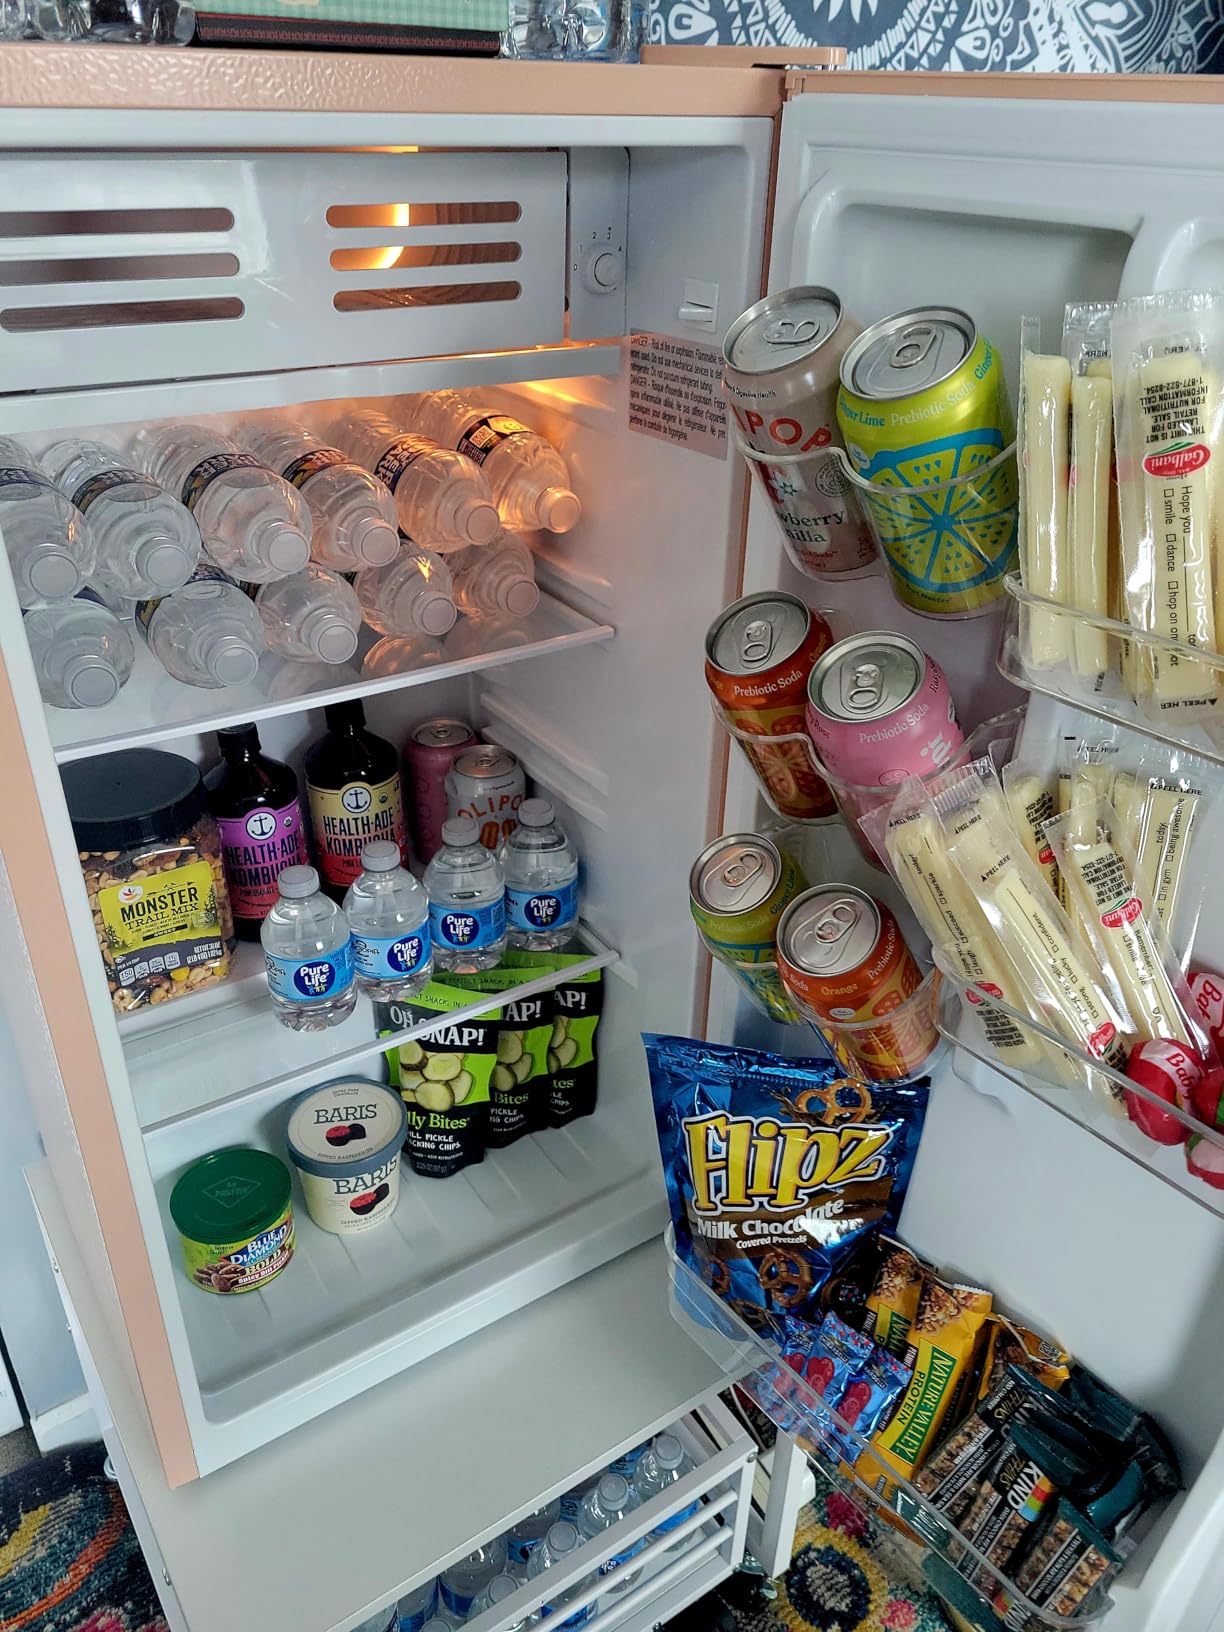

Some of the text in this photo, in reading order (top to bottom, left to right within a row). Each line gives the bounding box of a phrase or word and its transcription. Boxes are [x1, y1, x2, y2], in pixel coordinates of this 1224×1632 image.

[1140, 386, 1208, 406] INFORMATION CALL
[1143, 376, 1203, 395] 1-877-522-8254.
[860, 412, 885, 427] Lime
[890, 403, 945, 427] Prebiotic
[946, 380, 976, 407] Soda
[1144, 396, 1205, 415] FOR NUTRITIONAL
[1152, 408, 1198, 422] RETAIL SALE.
[1152, 424, 1165, 432] FOR
[1146, 434, 1159, 444] NOT
[1150, 449, 1205, 470] Galbani
[1181, 486, 1193, 534] Hope you
[1164, 499, 1178, 625] smile dance hop on
[734, 682, 778, 697] Prebiotic
[777, 670, 804, 689] Soda
[860, 723, 908, 744] Prebiotic
[906, 702, 929, 727] Soda
[1156, 822, 1168, 844] today.
[1163, 868, 1172, 884] gym
[1168, 834, 1180, 854] being
[928, 872, 944, 898] sparkle
[120, 886, 200, 922] MONSTER
[530, 898, 556, 908] Pure
[533, 906, 555, 917] Life
[125, 912, 170, 930] TRAIL
[172, 902, 200, 916] MIX
[446, 915, 474, 926] Pure
[946, 910, 965, 939] succeed
[449, 924, 471, 938] Life
[393, 938, 419, 954] Pure
[397, 948, 418, 962] Life
[1032, 912, 1072, 977] lucky confident
[300, 962, 329, 977] Pure
[304, 973, 328, 986] Life
[789, 972, 809, 992] Soda
[820, 983, 858, 996] Orange
[868, 942, 896, 979] Prebiotic
[554, 990, 587, 1010] AP!
[506, 1000, 543, 1022] AP!
[552, 1079, 575, 1090] tes
[494, 1092, 529, 1104] Bites
[313, 1103, 378, 1124] BARIS
[428, 1112, 468, 1130] Bites
[490, 1108, 518, 1116] PICKLE
[504, 1114, 524, 1124] CHIPS
[425, 1133, 454, 1142] PICKLE
[438, 1142, 462, 1150] CHIPS
[684, 1115, 890, 1211] Flipz
[332, 1156, 398, 1195] BARIS
[697, 1198, 844, 1240] Milk Chocolate
[230, 1224, 288, 1264] DIAMOND
[247, 1230, 276, 1253] BLUE
[736, 1234, 808, 1250] Covered Pretzels
[245, 1249, 282, 1276] BOLD
[238, 1268, 273, 1284] Spicy Dill
[897, 1370, 926, 1425] PROTEIN
[899, 1351, 953, 1460] NATURE VALLEY
[1004, 1460, 1043, 1511] KIND
